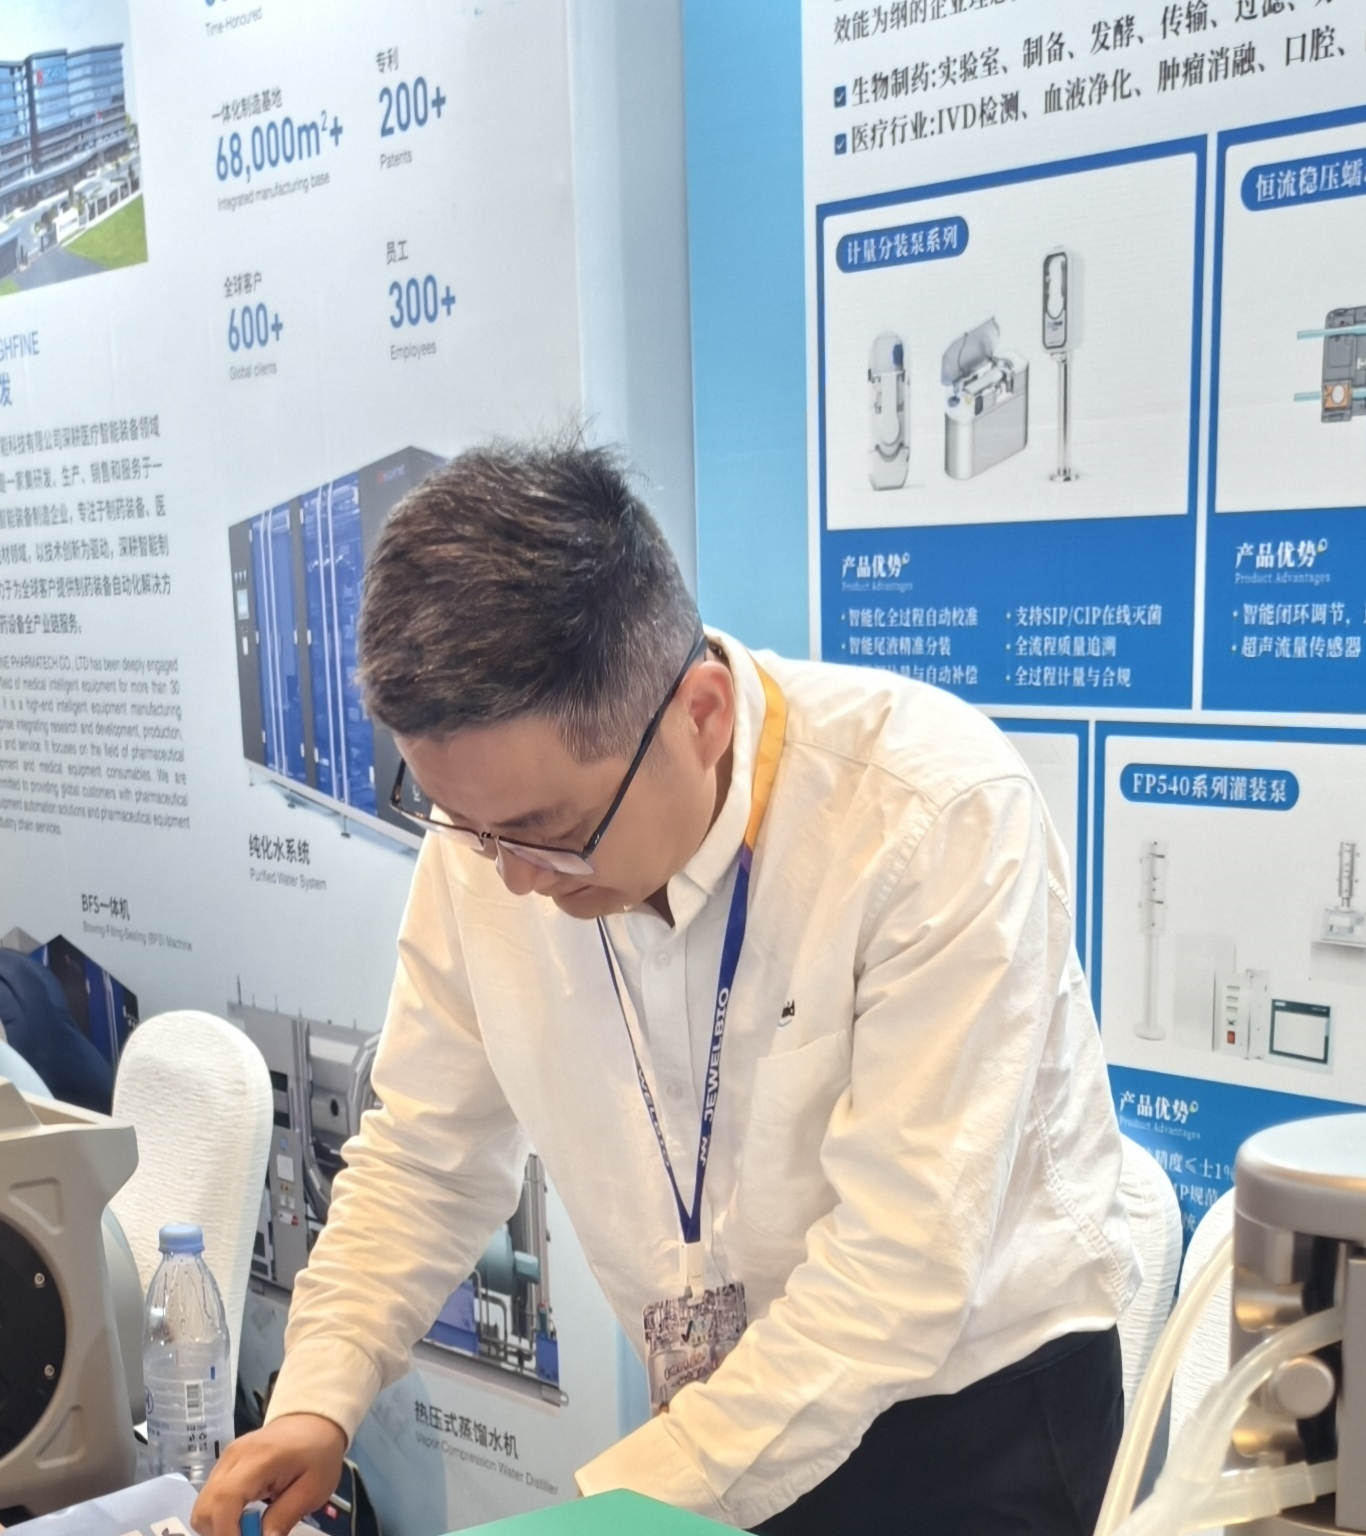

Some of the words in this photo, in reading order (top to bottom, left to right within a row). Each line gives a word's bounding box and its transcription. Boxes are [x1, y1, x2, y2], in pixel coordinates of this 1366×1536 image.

[375, 46, 399, 74] 专利
[212, 86, 283, 124] 一体化制造基地
[379, 75, 446, 138] 200+
[380, 149, 412, 170] Patents
[217, 188, 254, 212] Integrated
[255, 177, 309, 205] manufacturing
[310, 171, 330, 190] base
[386, 239, 409, 265] 员工
[846, 223, 958, 266] 计量分装泵系列
[223, 271, 262, 298] 全球客户
[389, 274, 456, 329] 300+
[228, 302, 283, 352] 600+
[390, 341, 437, 361] Employees
[229, 364, 252, 381] Global
[254, 361, 277, 378] clients
[841, 553, 902, 579] 产品优势
[1235, 540, 1317, 570] 产品优势
[1235, 572, 1272, 585] Product
[1274, 570, 1331, 586] Advantages
[848, 606, 979, 628] 智能化全过程自动校准
[1015, 603, 1163, 627] 支持SIP/CIP在线灭菌
[1241, 636, 1362, 660] 超声流量传感器
[1015, 666, 1133, 688] 全过程计量与合规
[1132, 771, 1288, 804] FP540系列灌装泵
[248, 833, 311, 866] 纯化水系统
[250, 868, 277, 886] Purified
[276, 872, 299, 888] Water
[300, 875, 327, 892] System
[81, 893, 131, 921] BFS一体机
[704, 987, 730, 1123] JEWELBIO
[1120, 1090, 1189, 1124] 产品优势
[415, 1400, 519, 1460] 热压式蒸馏水机
